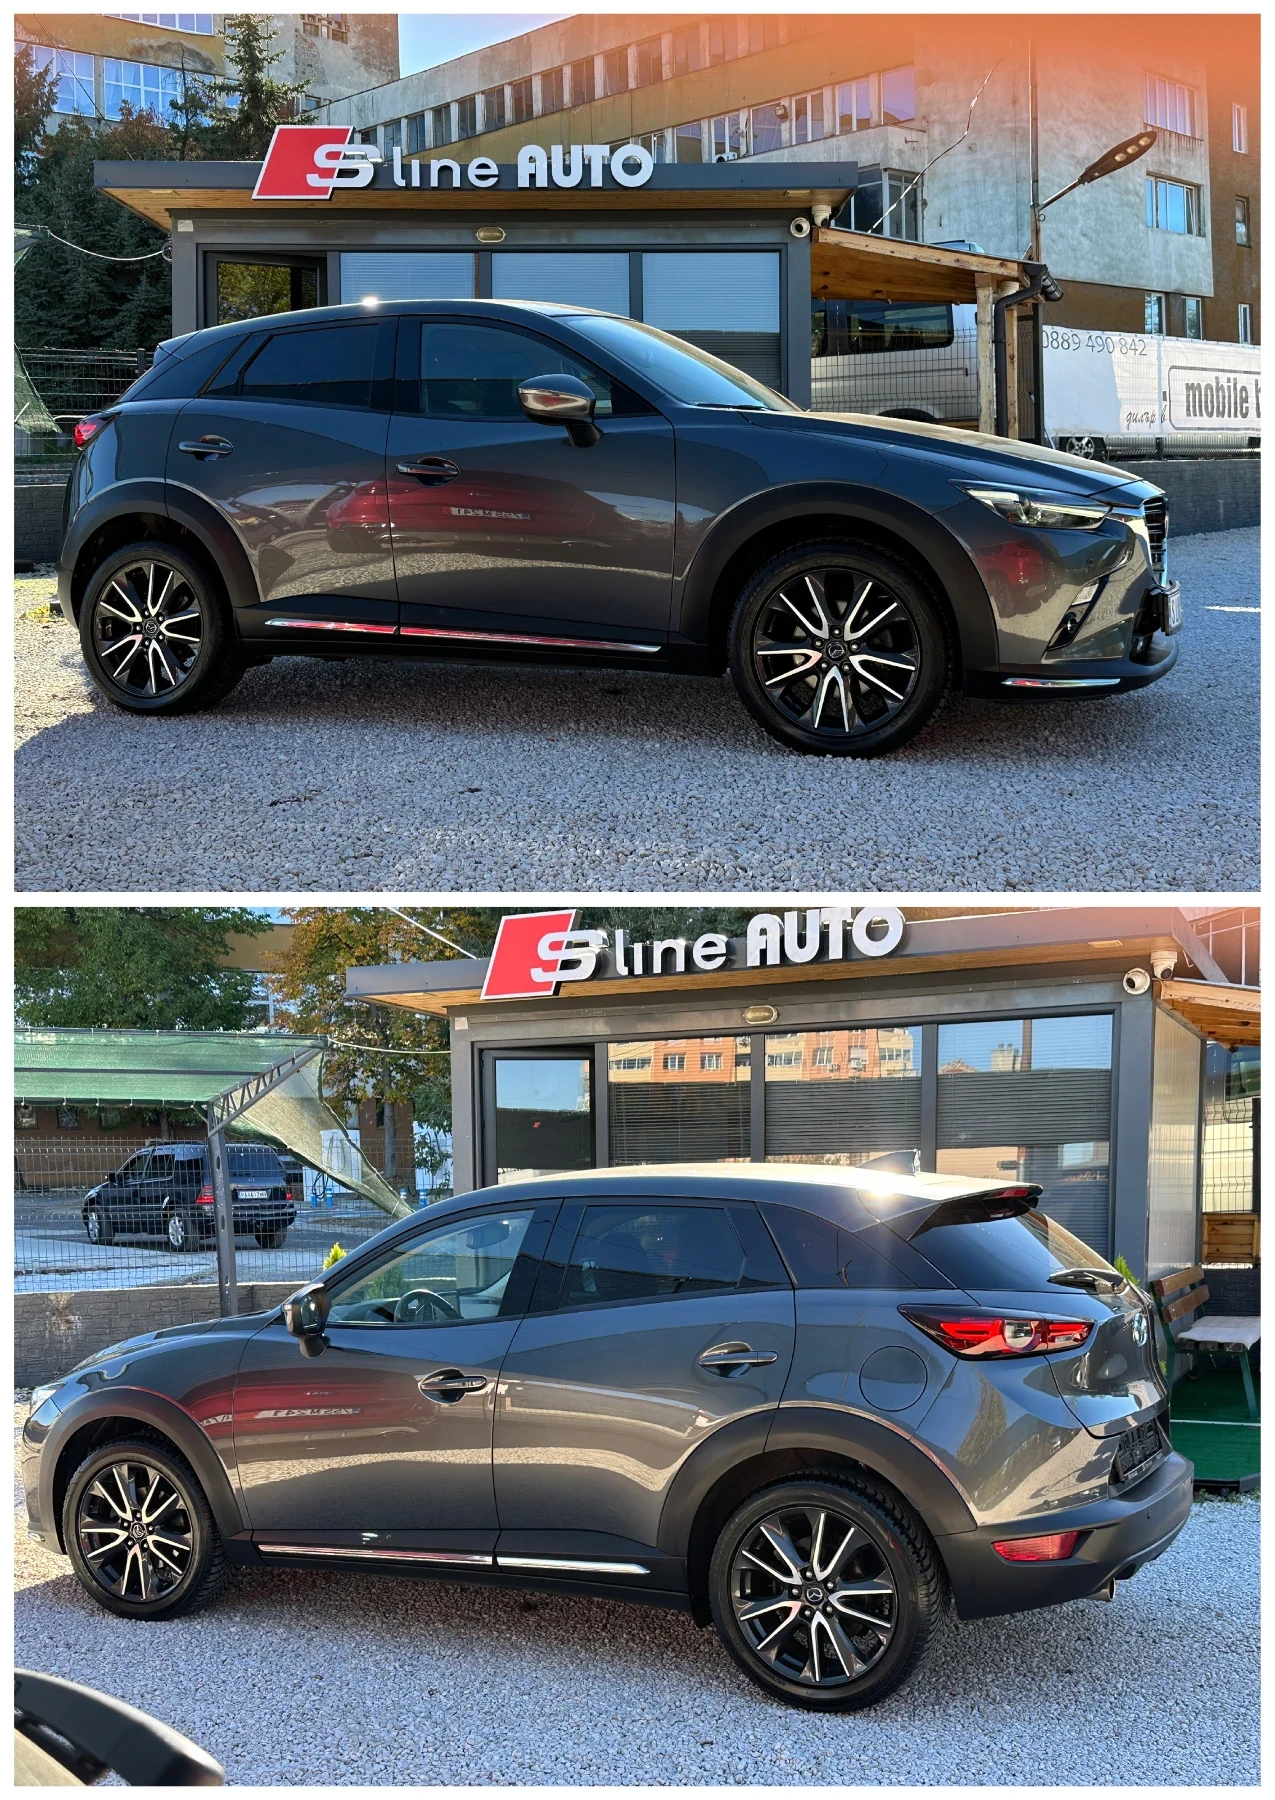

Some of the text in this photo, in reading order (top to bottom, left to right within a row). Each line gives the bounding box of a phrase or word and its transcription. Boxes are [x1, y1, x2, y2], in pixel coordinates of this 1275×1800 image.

[306, 143, 654, 188] S line AUTO
[1042, 330, 1148, 356] 0889 490 842
[1185, 376, 1250, 419] mobile
[530, 907, 905, 983] S line AUTO
